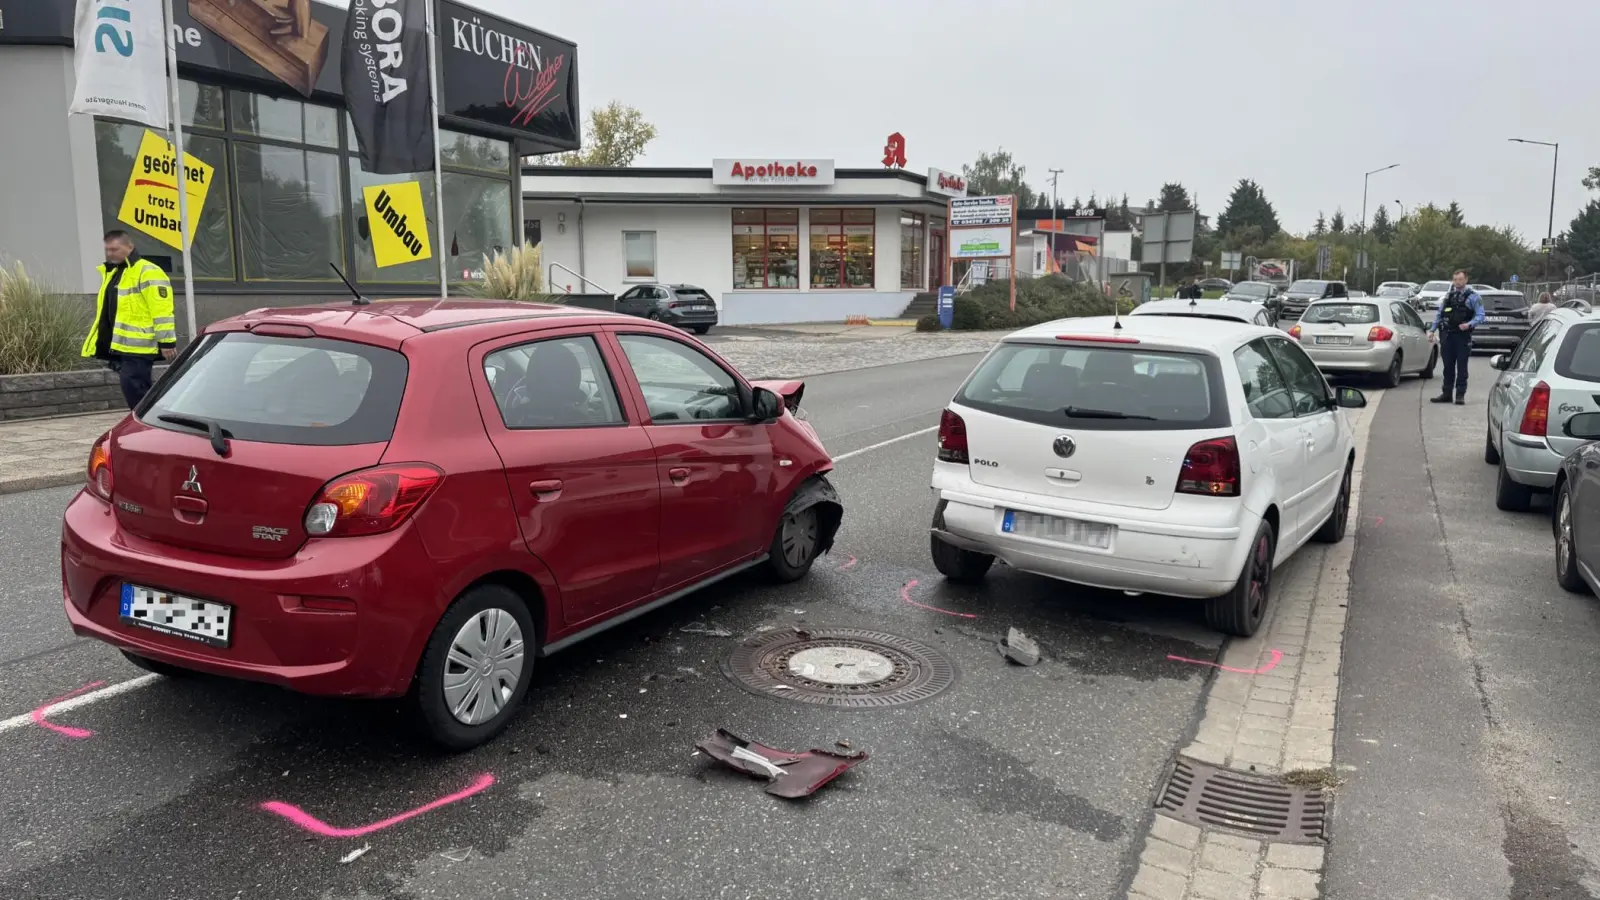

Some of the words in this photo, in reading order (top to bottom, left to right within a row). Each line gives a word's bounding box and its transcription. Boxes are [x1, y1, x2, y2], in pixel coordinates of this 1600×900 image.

[371, 0, 408, 103] ORA
[451, 16, 542, 72] KÜCHEN
[358, 43, 382, 102] systems
[143, 154, 205, 184] geöfnet
[731, 161, 818, 181] Apotheke
[937, 171, 965, 191] Apotheke
[147, 193, 176, 211] trotz
[1075, 208, 1095, 217] SWS
[374, 189, 423, 257] Umbau
[974, 458, 999, 468] POLO
[252, 525, 289, 536] SPACE
[252, 532, 282, 541] STAR
